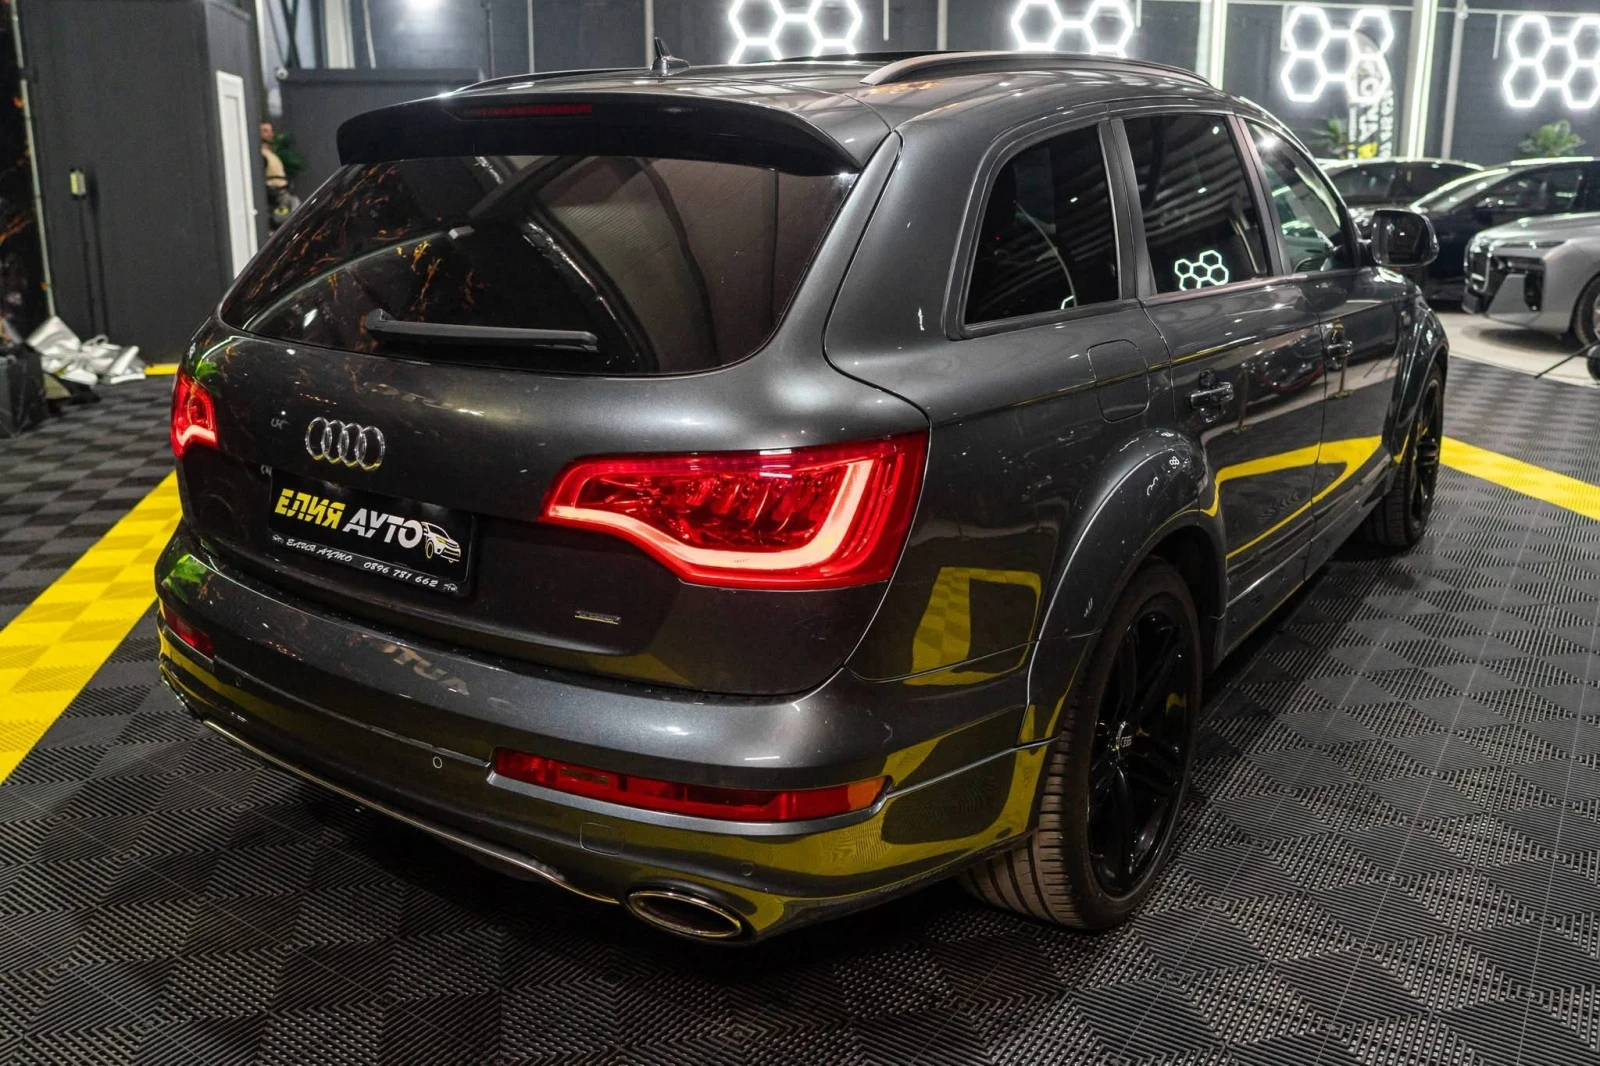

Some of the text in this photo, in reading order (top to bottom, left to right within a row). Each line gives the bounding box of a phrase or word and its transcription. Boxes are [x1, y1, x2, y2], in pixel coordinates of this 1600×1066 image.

[275, 488, 423, 549] ЕЛИЯ АУТО
[363, 562, 390, 574] 0896
[393, 569, 412, 580] 781
[415, 576, 438, 587] 662
